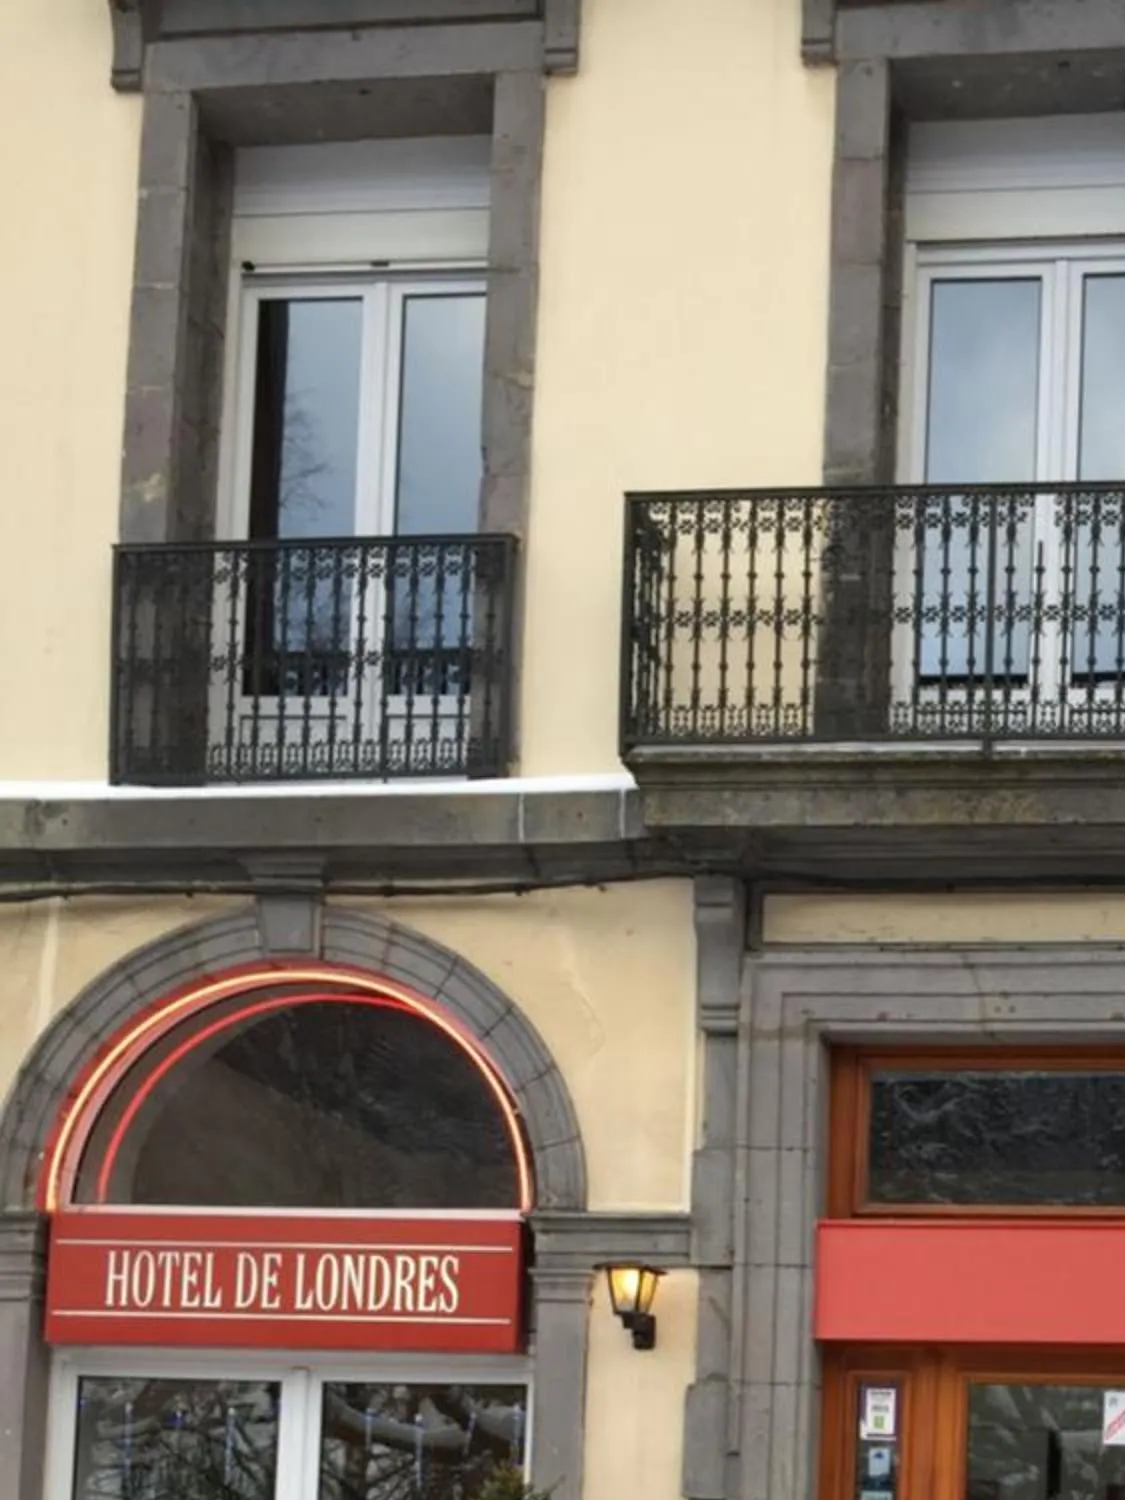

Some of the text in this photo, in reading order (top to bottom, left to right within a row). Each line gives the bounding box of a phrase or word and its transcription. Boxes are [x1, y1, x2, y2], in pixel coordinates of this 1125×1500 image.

[105, 1249, 460, 1313] HOTEL DE LONDRES
